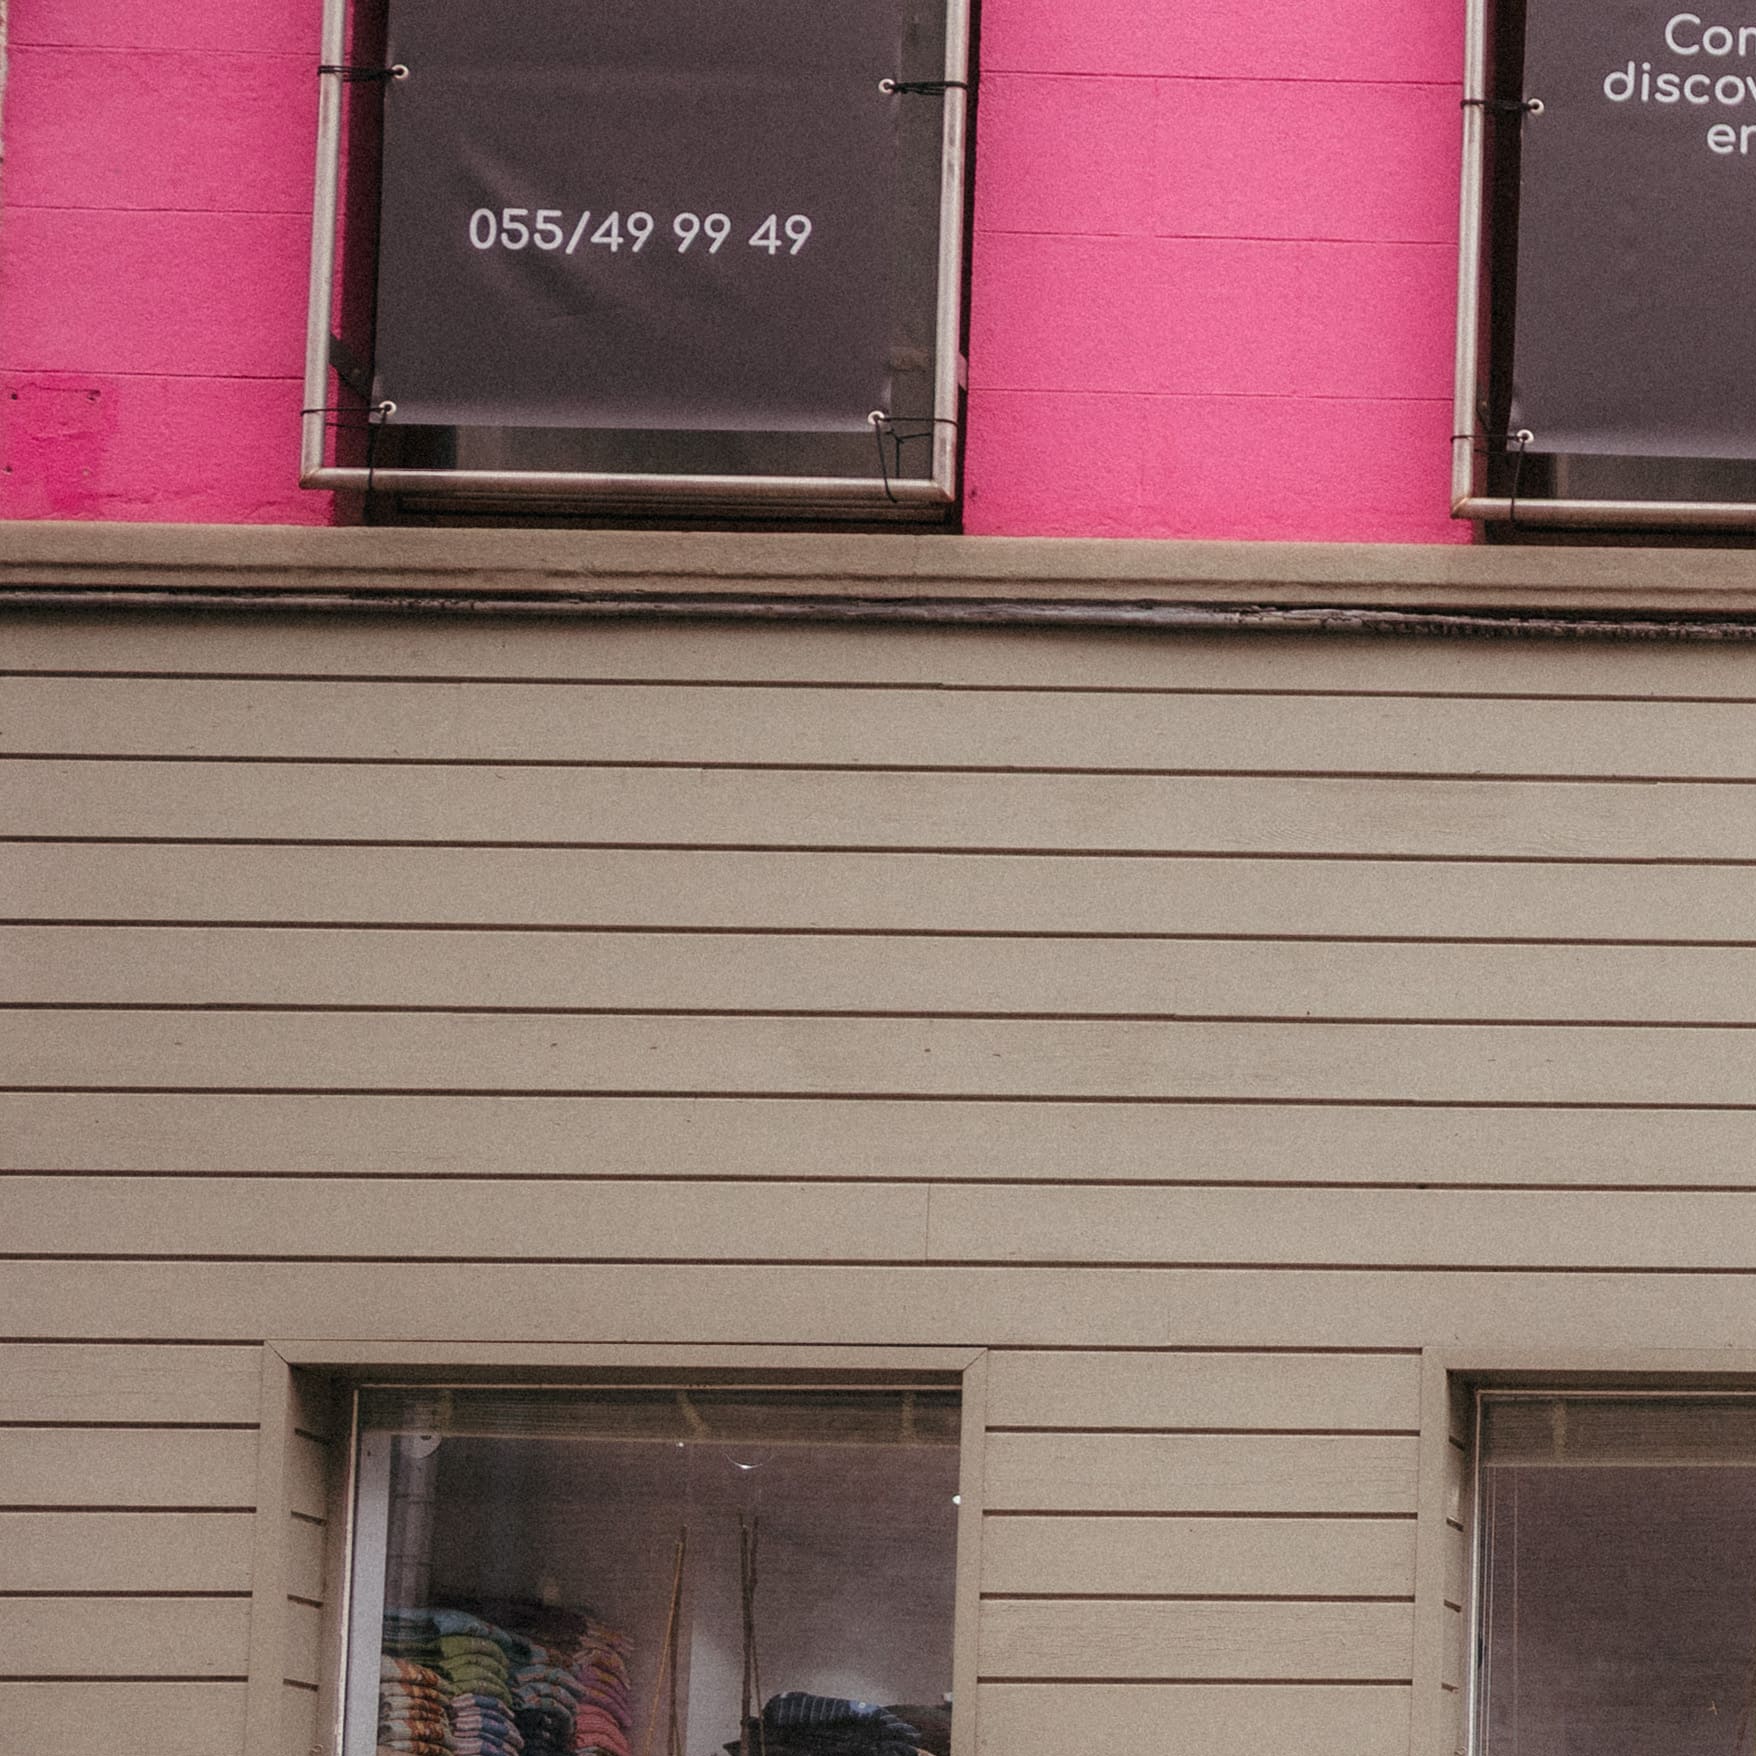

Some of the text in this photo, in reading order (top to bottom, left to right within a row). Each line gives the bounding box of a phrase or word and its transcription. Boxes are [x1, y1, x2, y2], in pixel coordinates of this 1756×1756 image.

[469, 207, 813, 256] 055/49 99 49
